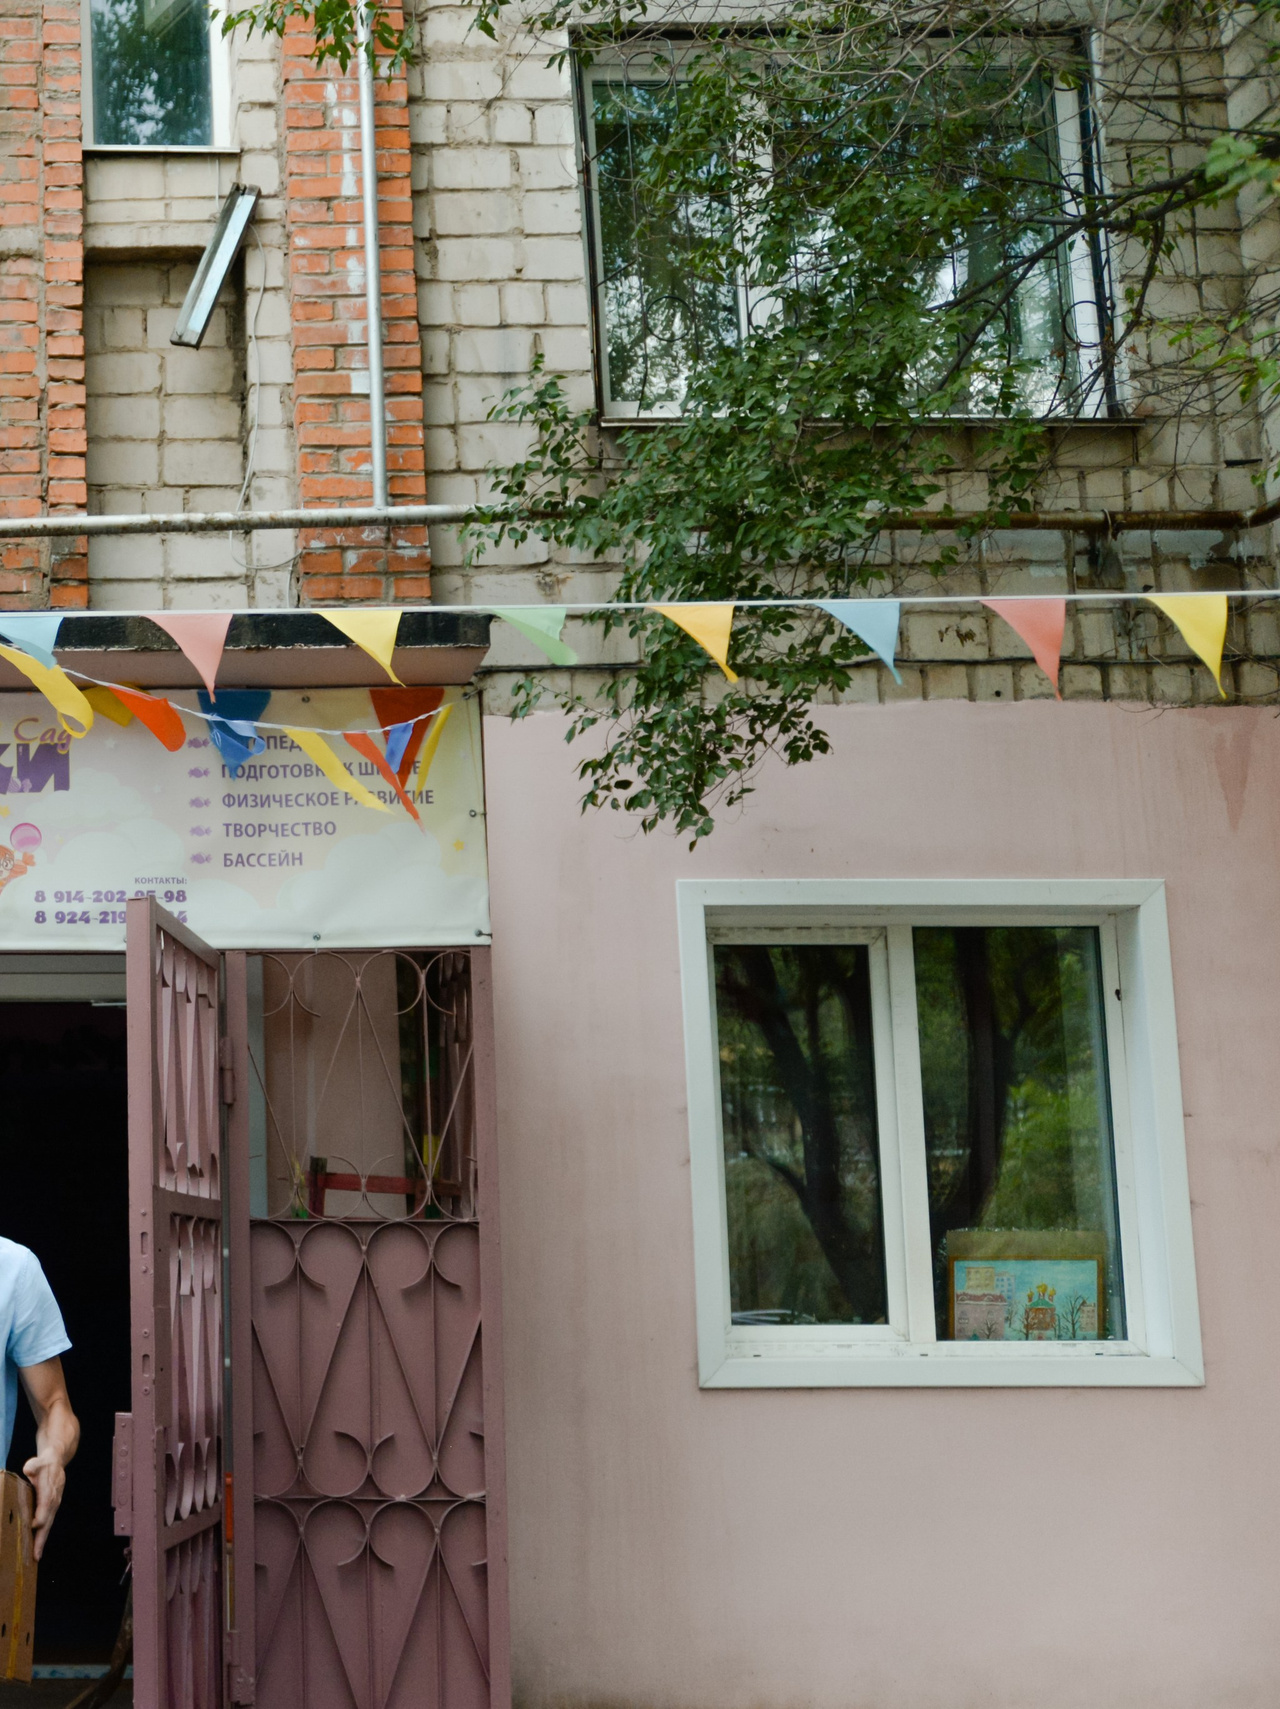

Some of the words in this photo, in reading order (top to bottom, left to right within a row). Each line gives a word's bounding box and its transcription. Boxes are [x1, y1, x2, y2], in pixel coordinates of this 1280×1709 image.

[221, 762, 327, 782] ПОДГОТОВК
[222, 791, 340, 808] ФИЗИЧЕСКОЕ
[222, 821, 337, 838] ТВОРЧЕСТВО
[223, 849, 304, 868] БАССЕЙН
[134, 876, 188, 885] КОНТАКТЫ:
[34, 890, 47, 903] 8
[34, 911, 47, 924] 8
